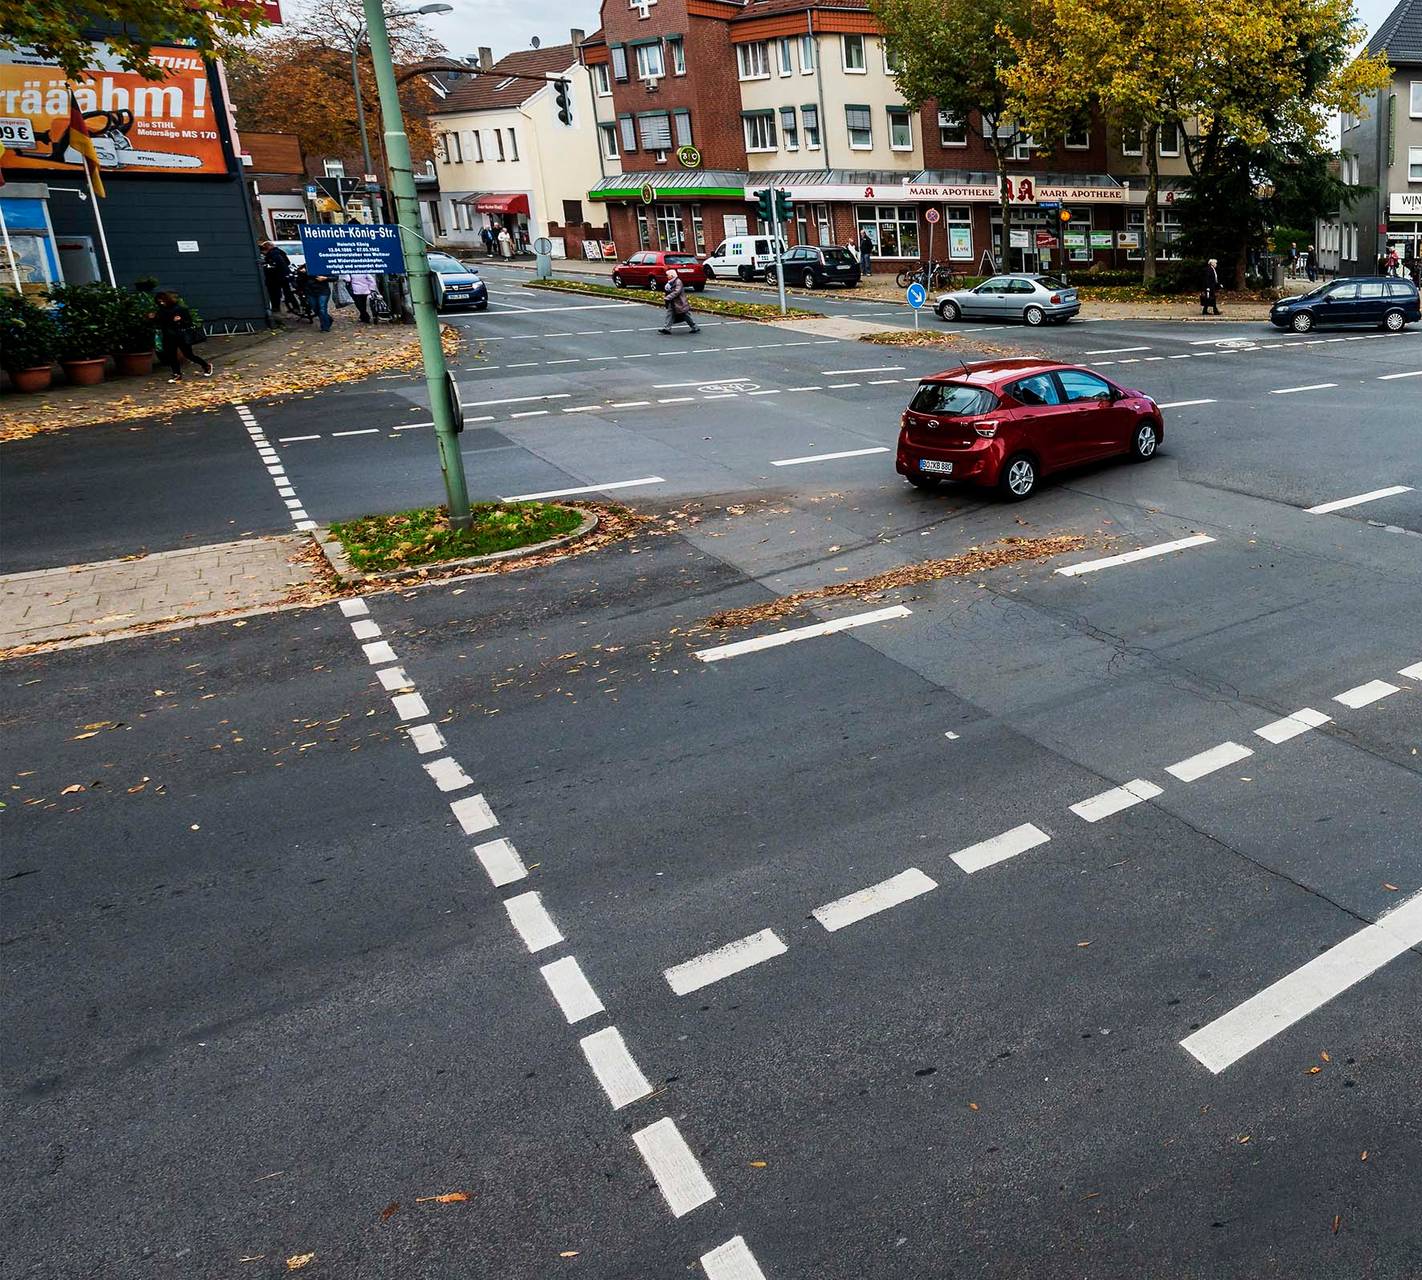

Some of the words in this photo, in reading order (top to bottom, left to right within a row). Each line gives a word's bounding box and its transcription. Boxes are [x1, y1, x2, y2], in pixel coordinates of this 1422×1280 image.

[150, 55, 204, 71] STIHL
[151, 121, 176, 129] STIHL
[0, 126, 15, 140] 9
[17, 127, 29, 140] €
[137, 128, 180, 139] Motorsäge
[181, 130, 198, 138] MS
[200, 131, 217, 139] 170
[909, 187, 939, 196] MARK
[941, 188, 995, 197] APOTHEKE
[1040, 189, 1069, 198] MARK
[1070, 190, 1122, 199] APOTHEKE
[304, 227, 397, 239] Heinrich-König-Str.
